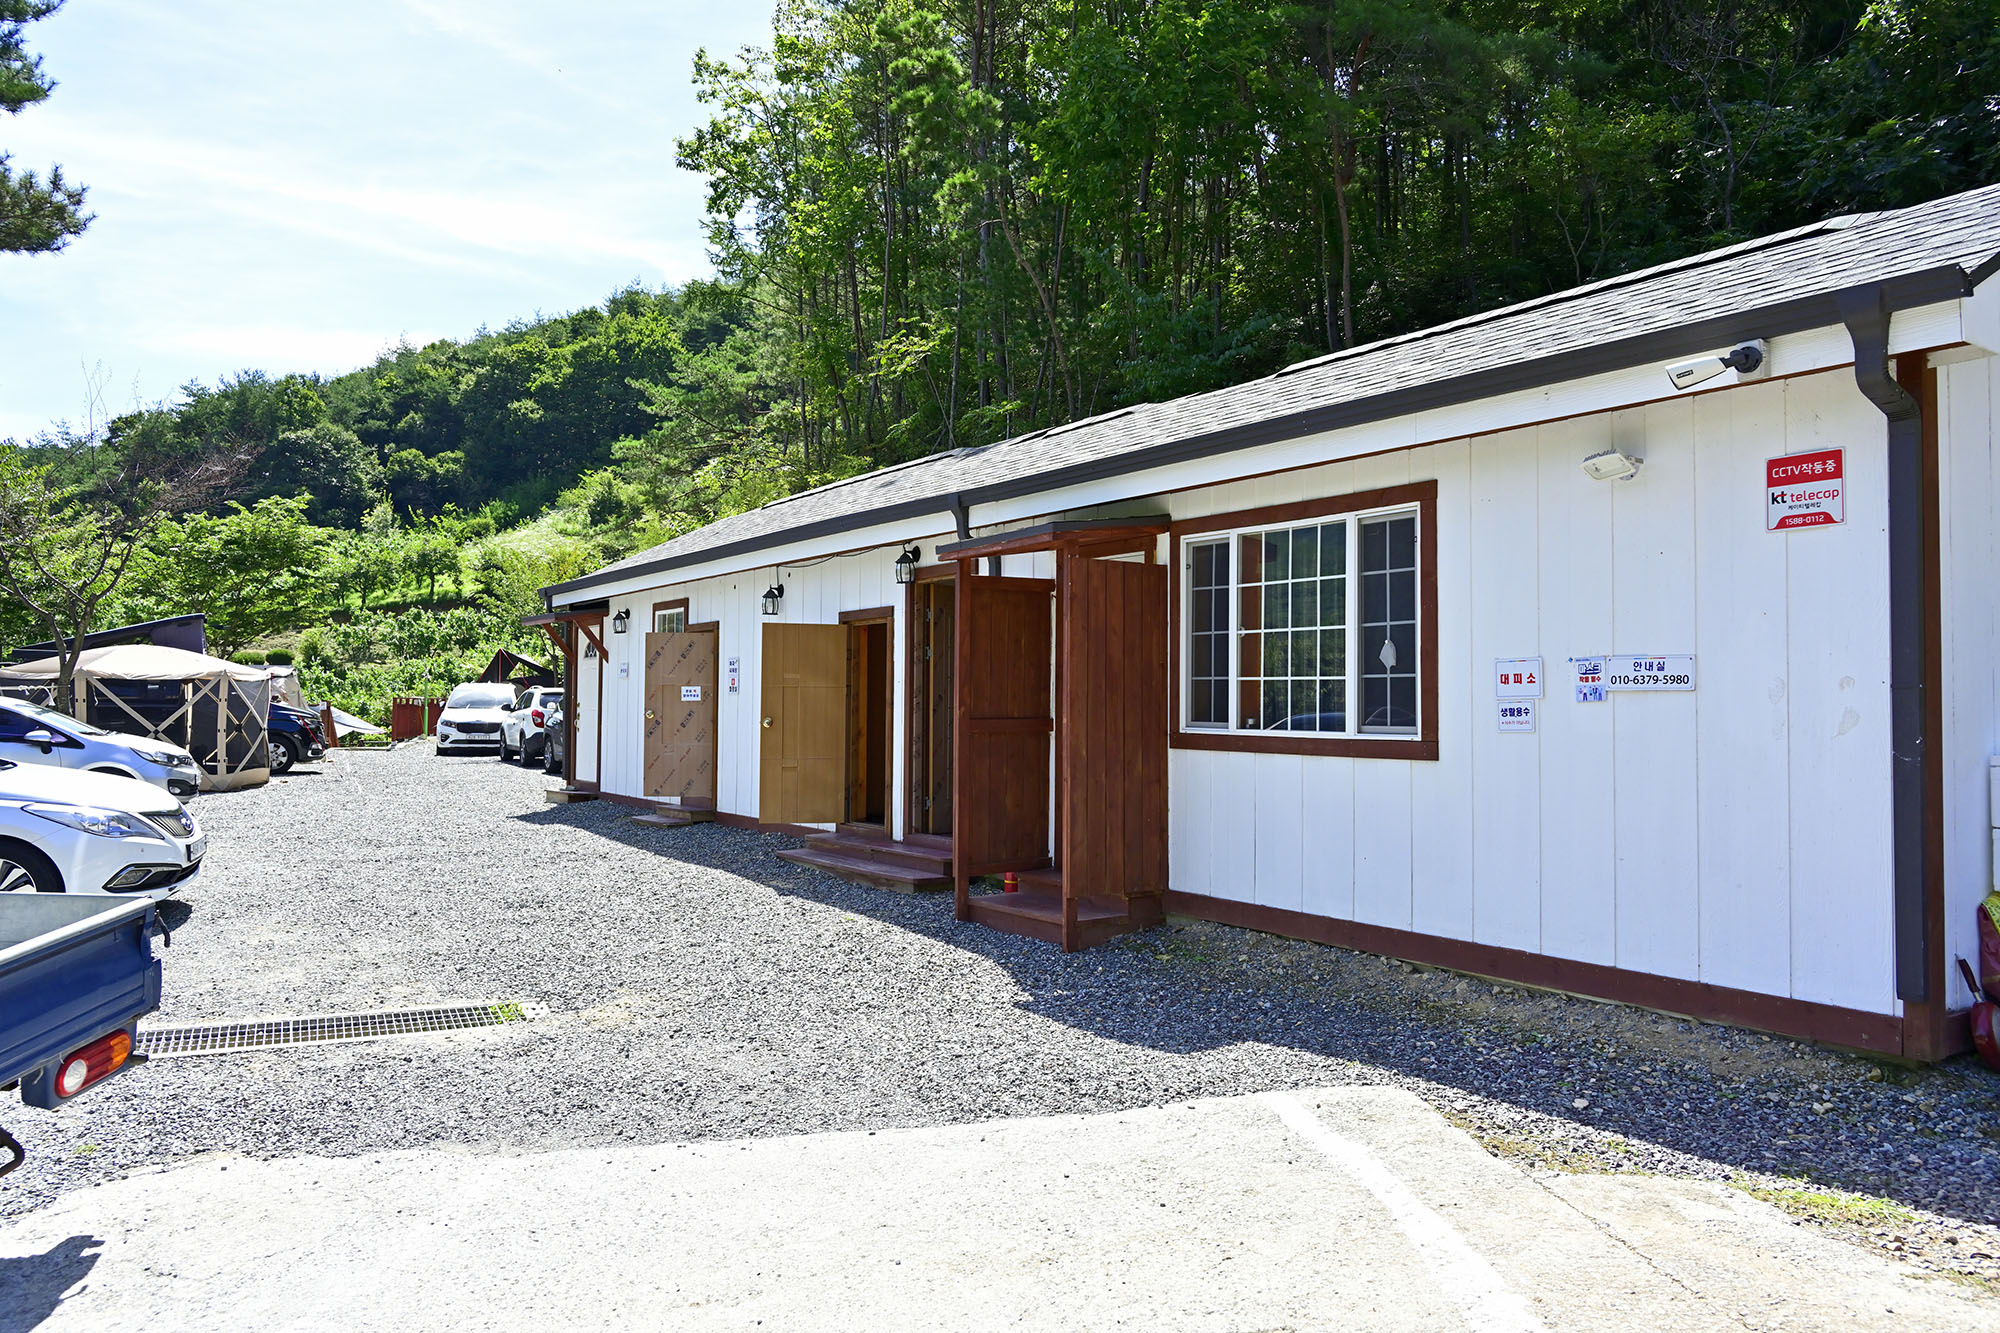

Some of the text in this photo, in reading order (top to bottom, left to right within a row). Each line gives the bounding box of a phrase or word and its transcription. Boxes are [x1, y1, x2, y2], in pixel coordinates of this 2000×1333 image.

[1773, 460, 1836, 478] CCTV작동중
[1771, 489, 1839, 505] kt telecop
[1785, 515, 1824, 525] 1588-0112
[1578, 662, 1602, 675] 마스크
[1633, 661, 1665, 672] 안내실
[1500, 672, 1536, 685] 대피소
[1610, 674, 1689, 685] 010-6379-5980
[1500, 707, 1530, 718] 생활용수
